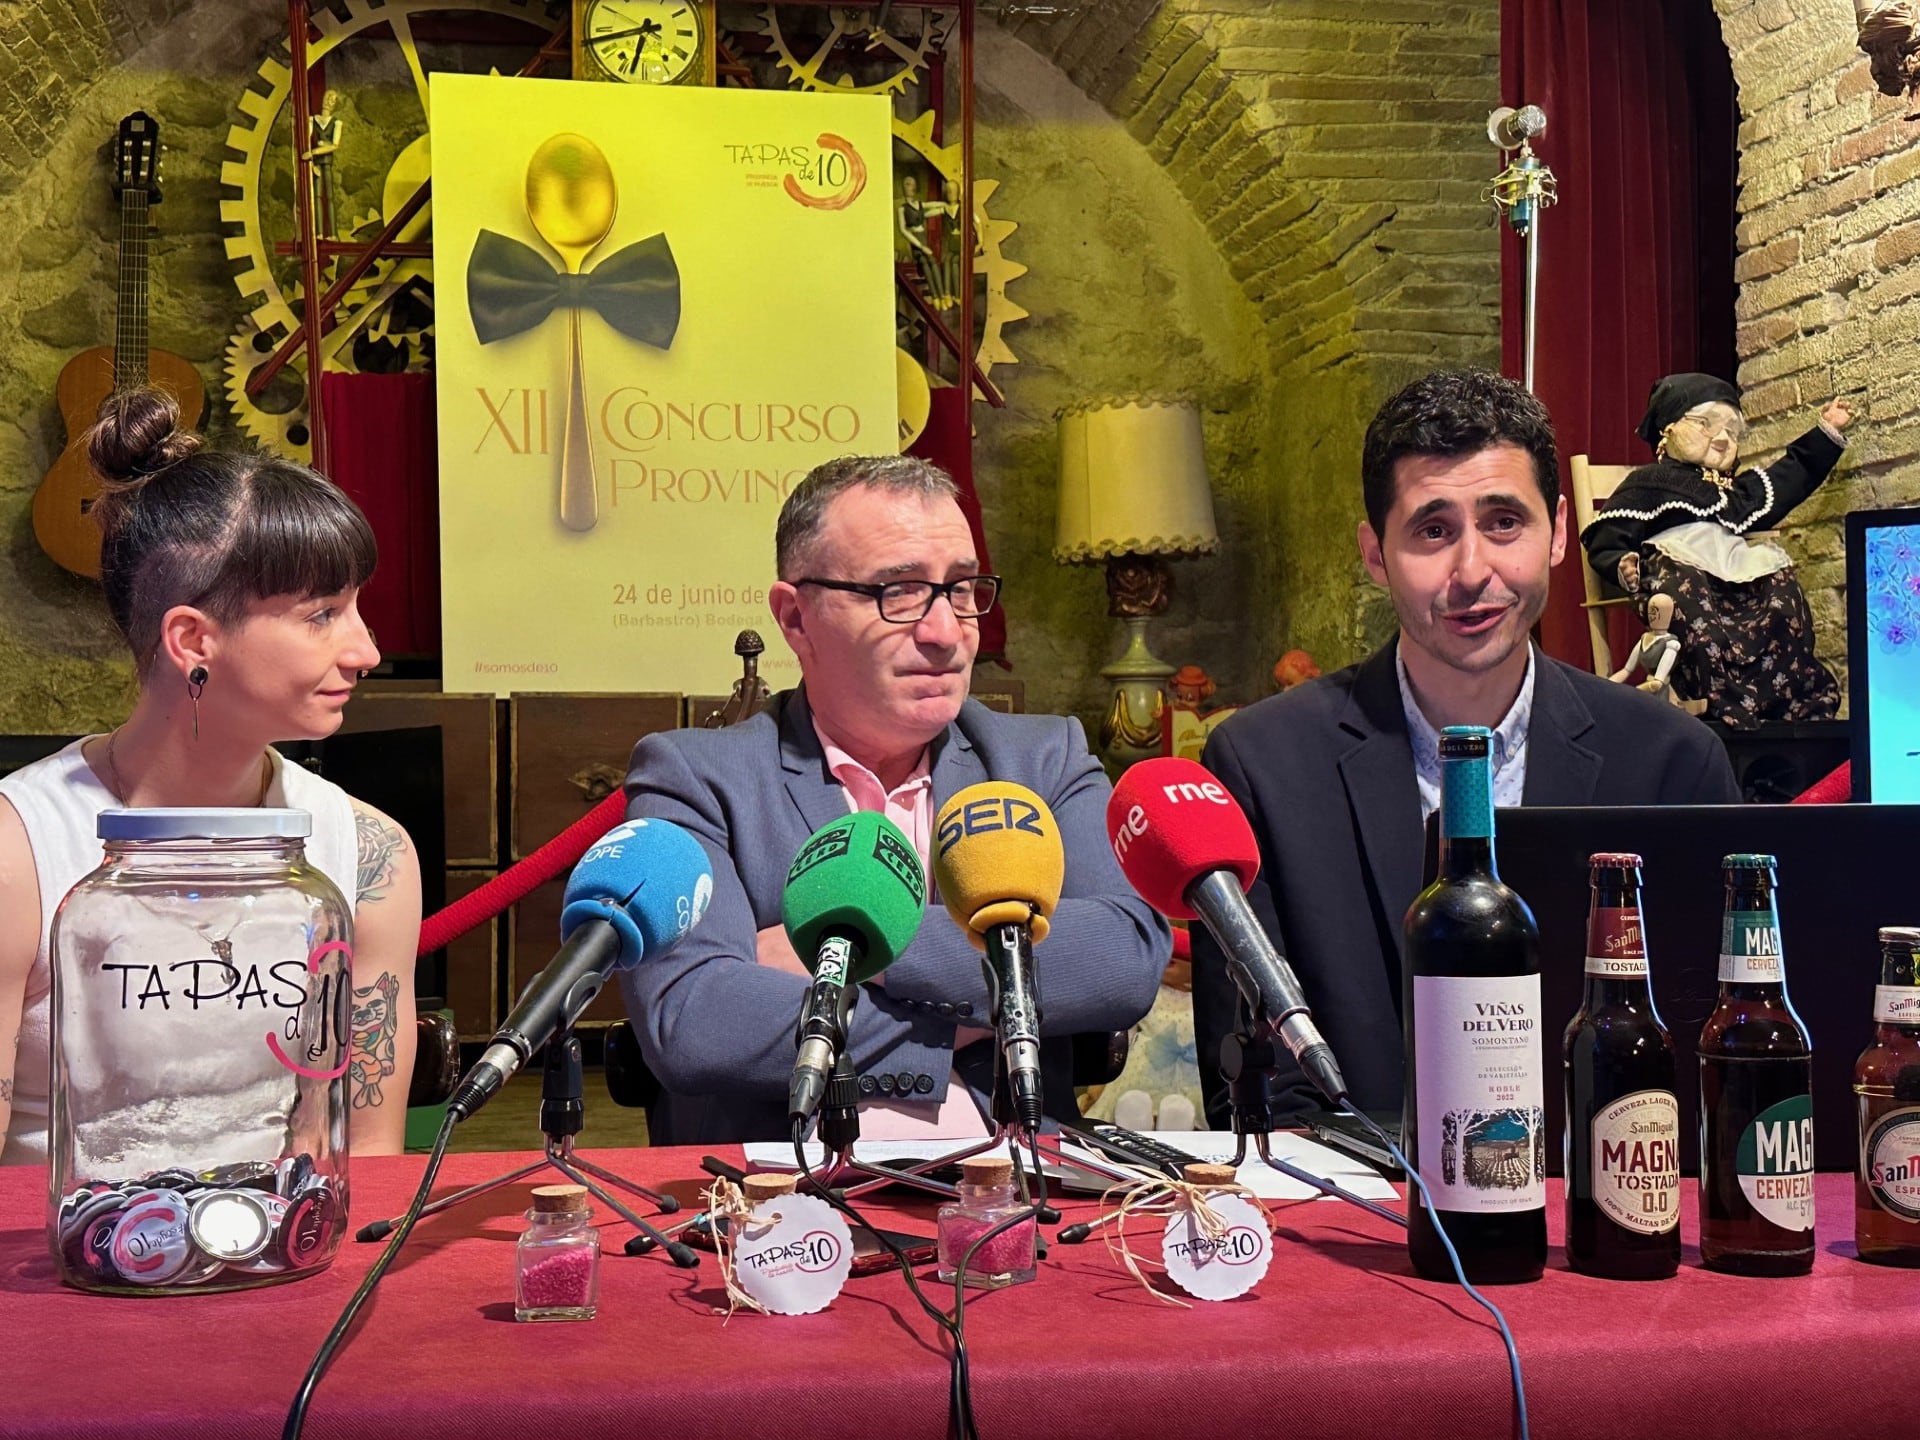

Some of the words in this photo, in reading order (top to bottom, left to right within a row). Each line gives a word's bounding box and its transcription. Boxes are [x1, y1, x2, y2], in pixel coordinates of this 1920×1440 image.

[723, 143, 810, 167] TAPAS
[815, 152, 847, 187] 10
[473, 387, 549, 455] XII
[600, 386, 862, 453] CONCURSO
[612, 584, 637, 605] 24
[646, 584, 672, 605] de
[679, 584, 736, 610] junio
[736, 585, 764, 605] de
[612, 613, 700, 629] (Barbastro)
[704, 613, 763, 628] Bodega
[1161, 781, 1230, 805] rne
[936, 797, 1045, 859] SER
[1113, 803, 1149, 864] rne
[577, 844, 625, 871] OPE
[101, 959, 308, 1011] TAPAS
[316, 968, 349, 1051] 10
[1475, 1001, 1525, 1016] VIÑAS
[1463, 1020, 1496, 1032] DEL
[1496, 1018, 1534, 1032] VERO
[1471, 1036, 1529, 1046] SOMONTANO
[1488, 1084, 1521, 1093] ROBLE
[1608, 1099, 1648, 1121] CERVEZA
[1649, 1097, 1671, 1107] LAGER
[1756, 1174, 1810, 1200] CERVEZA
[1625, 1212, 1660, 1228] MALTAS
[744, 1241, 806, 1269] TAPAS
[808, 1237, 833, 1265] 10
[1231, 1232, 1254, 1259] 10
